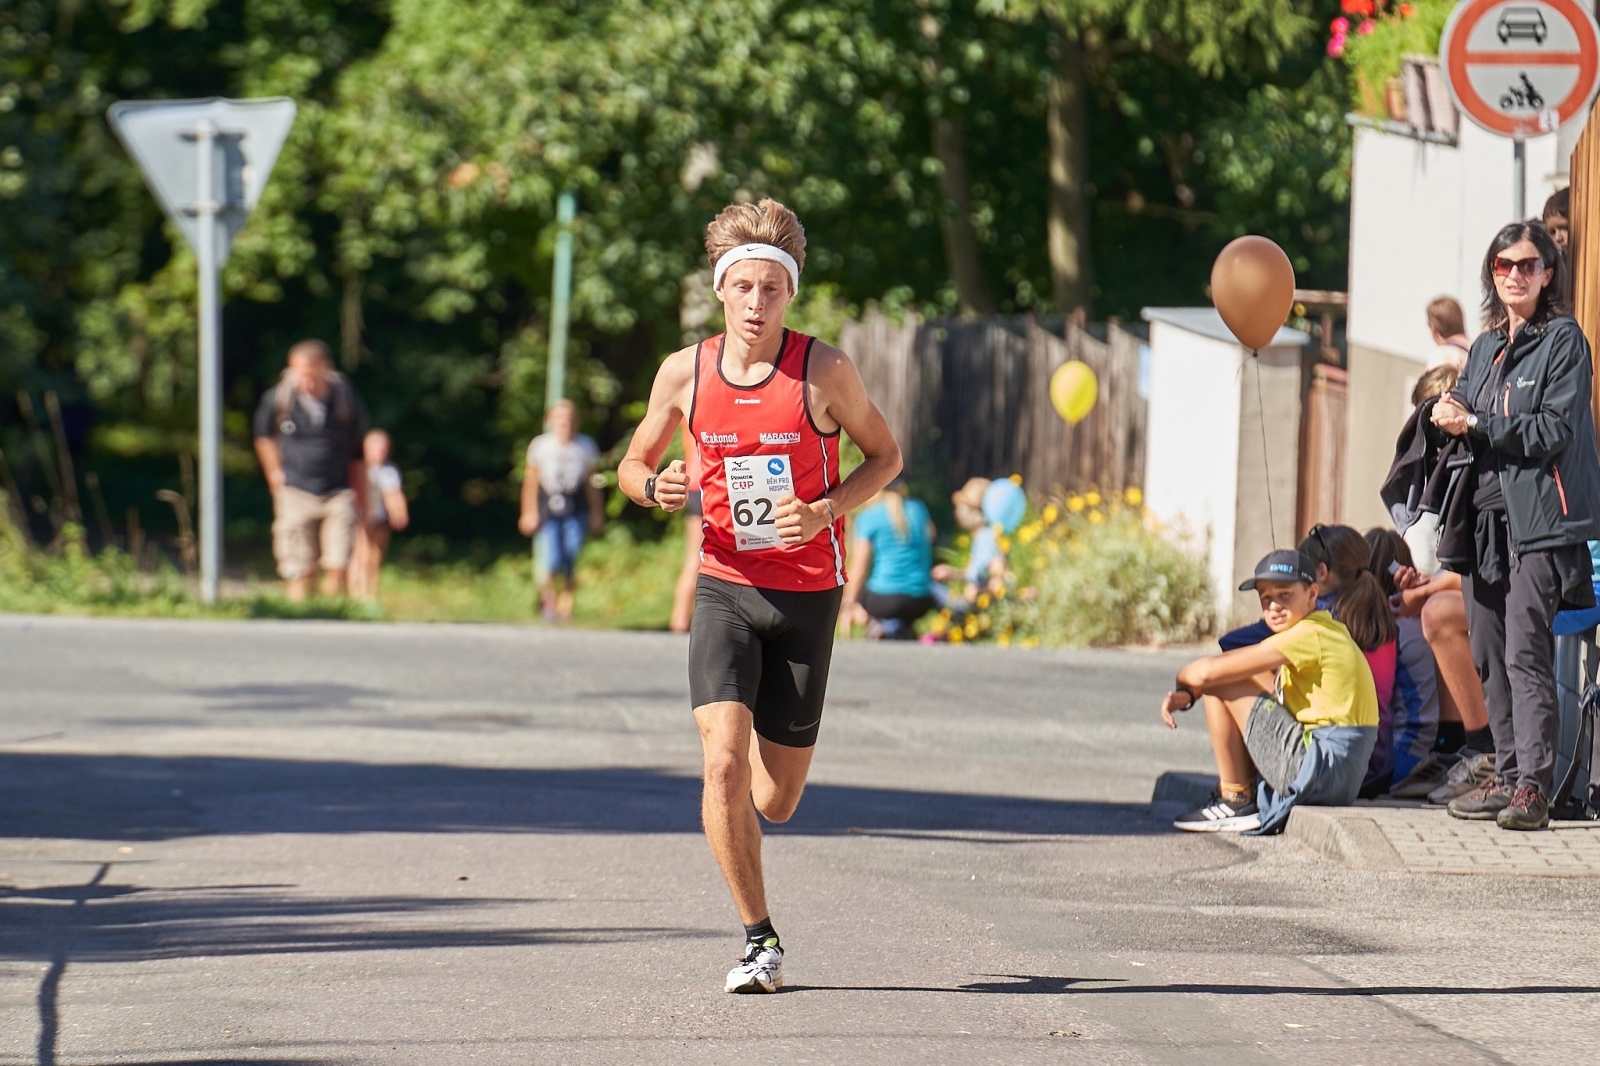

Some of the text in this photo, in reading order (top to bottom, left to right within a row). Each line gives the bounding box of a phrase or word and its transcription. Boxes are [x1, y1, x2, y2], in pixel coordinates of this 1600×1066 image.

[759, 431, 801, 442] MARATON
[731, 481, 754, 490] CUP
[769, 484, 790, 492] HOSPIC
